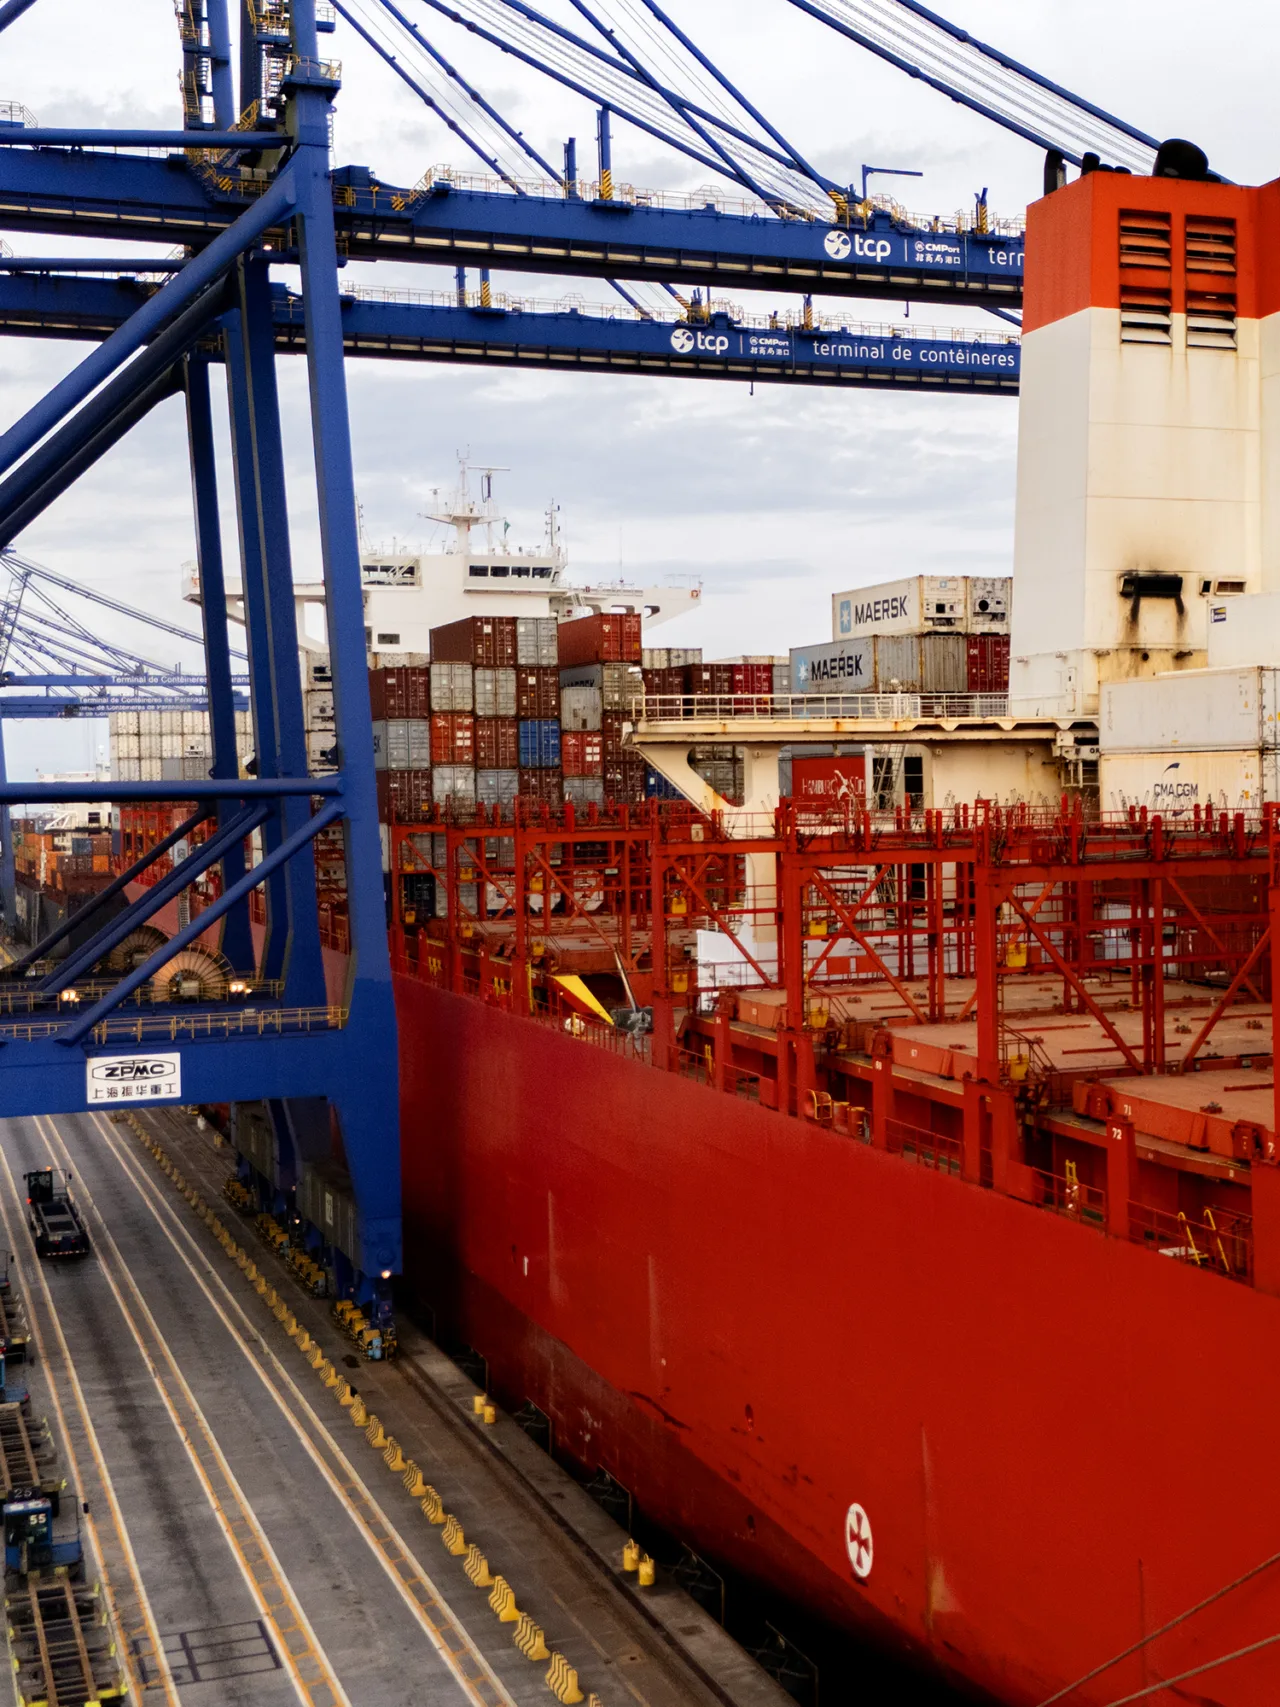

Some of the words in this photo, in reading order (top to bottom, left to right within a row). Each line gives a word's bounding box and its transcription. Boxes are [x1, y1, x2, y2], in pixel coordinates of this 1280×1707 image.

[854, 233, 892, 263] tcp
[697, 331, 729, 355] tcp
[813, 340, 884, 359] terminal
[892, 344, 912, 361] de
[919, 348, 1016, 367] contêineres
[854, 595, 908, 625] MAERSK
[811, 654, 863, 682] MAERSK
[111, 675, 147, 684] Terminal
[148, 675, 159, 684] de
[1154, 783, 1175, 797] CMA
[1176, 783, 1199, 798] CGM
[105, 1063, 165, 1078] ZPMC
[1112, 1127, 1123, 1140] 72
[30, 1513, 46, 1526] 55
